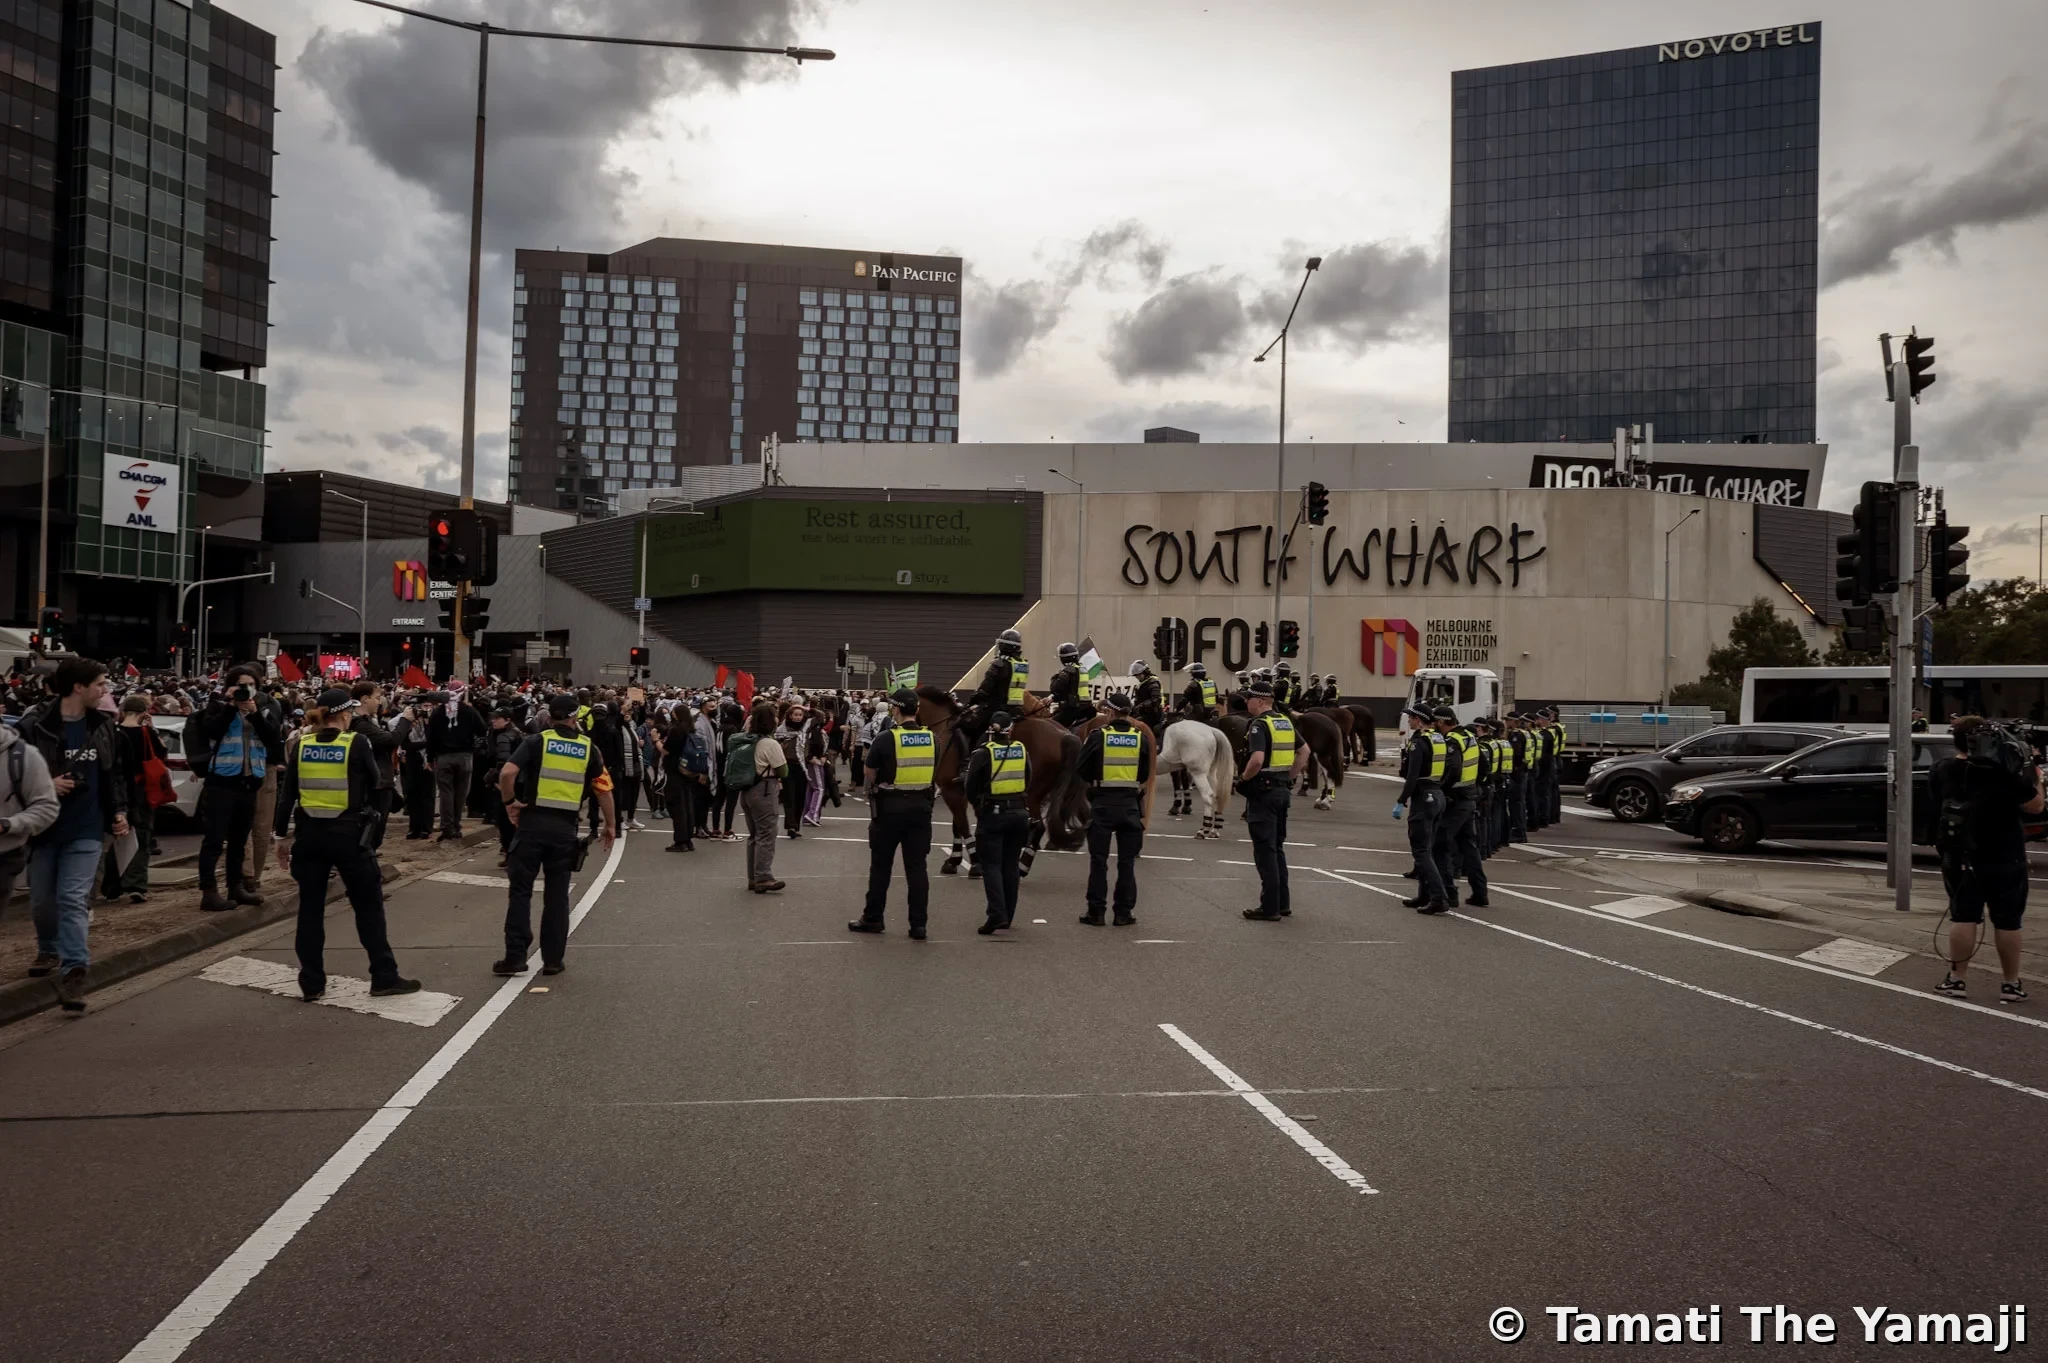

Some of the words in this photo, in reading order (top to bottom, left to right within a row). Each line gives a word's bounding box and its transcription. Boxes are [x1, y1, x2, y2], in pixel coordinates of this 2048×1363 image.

[1658, 25, 1814, 62] NOVOTEL
[871, 264, 899, 279] PAN
[902, 266, 957, 283] PACIFIC
[119, 470, 143, 482] CMA
[143, 474, 167, 486] CGM
[126, 512, 157, 528] ANL
[804, 506, 860, 529] Rest
[868, 509, 971, 533] assured,
[1122, 524, 1297, 587] SOUTH
[1323, 523, 1547, 587] WHARF
[392, 618, 425, 626] ENTRANCE
[1427, 619, 1492, 632] MELBOURNE
[1161, 617, 1250, 672] DFO
[1426, 634, 1497, 647] CONVENTION
[1426, 648, 1489, 662] EXHIBITION
[901, 734, 931, 745] Police
[1107, 735, 1137, 746] Police
[303, 747, 344, 761] Police
[547, 740, 586, 757] Police
